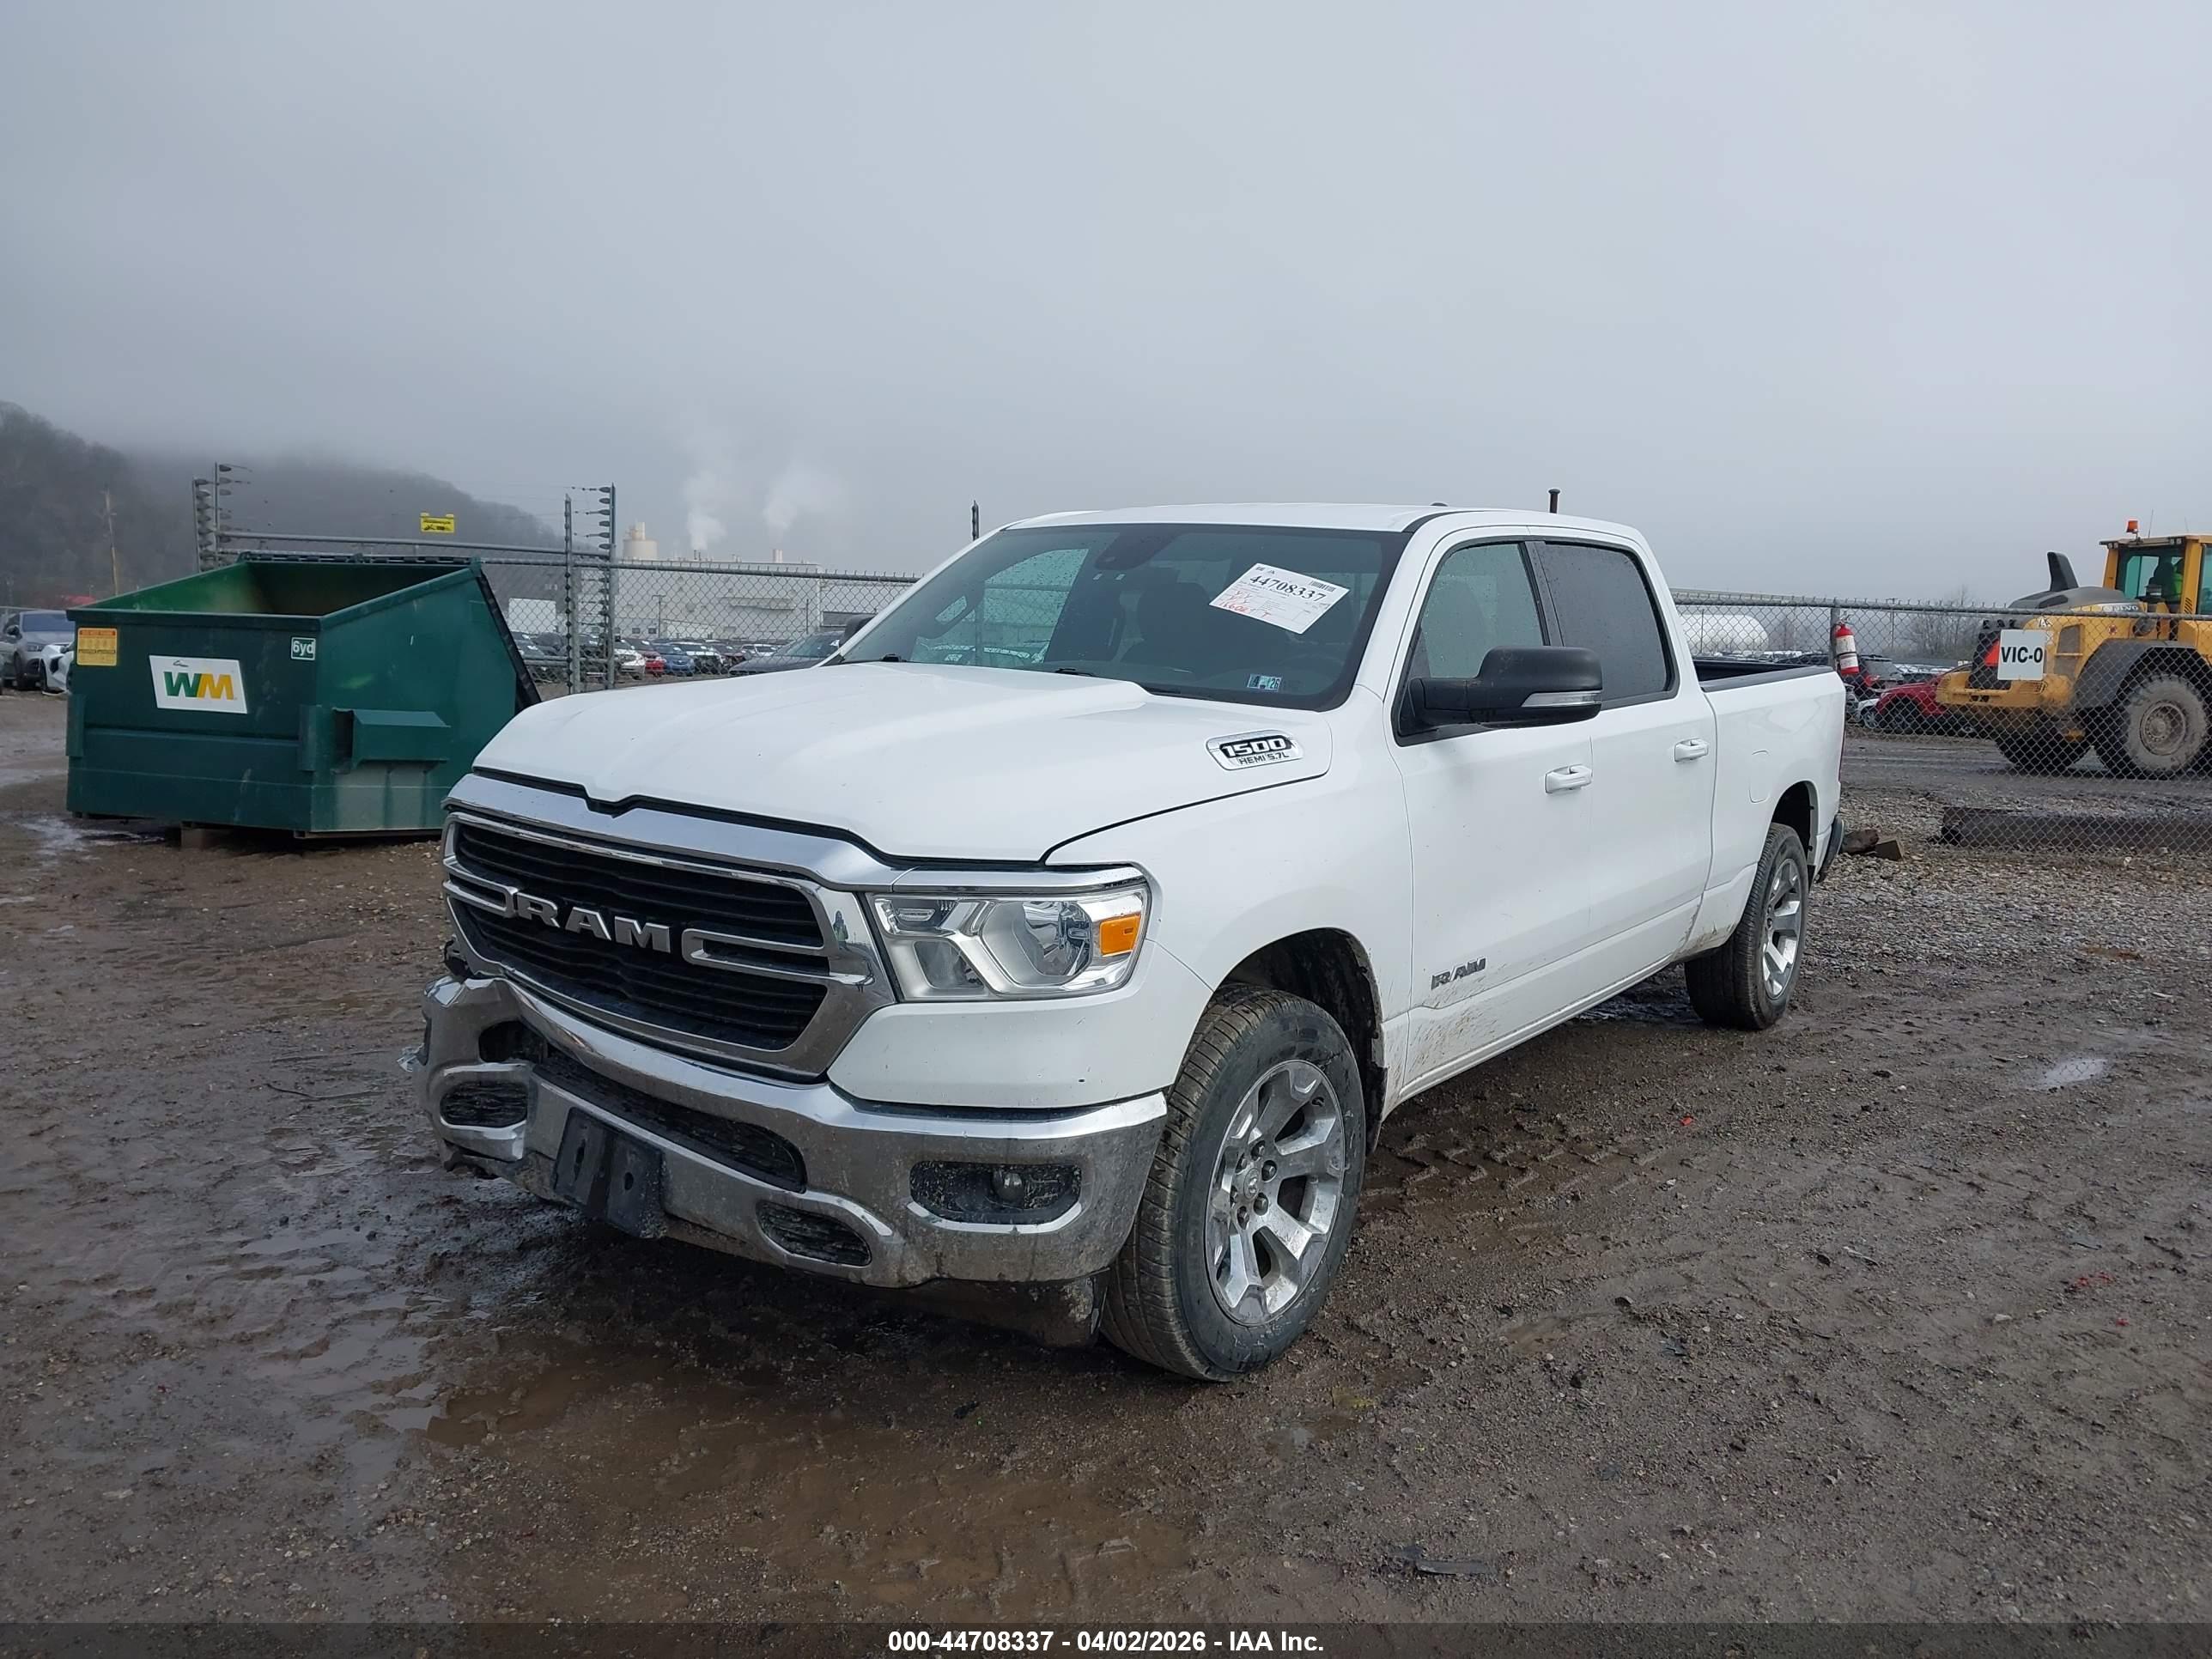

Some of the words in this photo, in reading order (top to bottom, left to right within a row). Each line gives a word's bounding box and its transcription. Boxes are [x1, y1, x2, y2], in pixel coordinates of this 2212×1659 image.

[1249, 575, 1327, 602] 44708337
[292, 640, 314, 656] 6yd
[163, 671, 234, 701] WM
[1269, 678, 1280, 689] 26
[1221, 738, 1287, 757] 1500
[1238, 755, 1267, 765] HEMI
[1267, 751, 1290, 761] 5.7L
[517, 892, 672, 953] RAM
[1431, 957, 1486, 990] RAM
